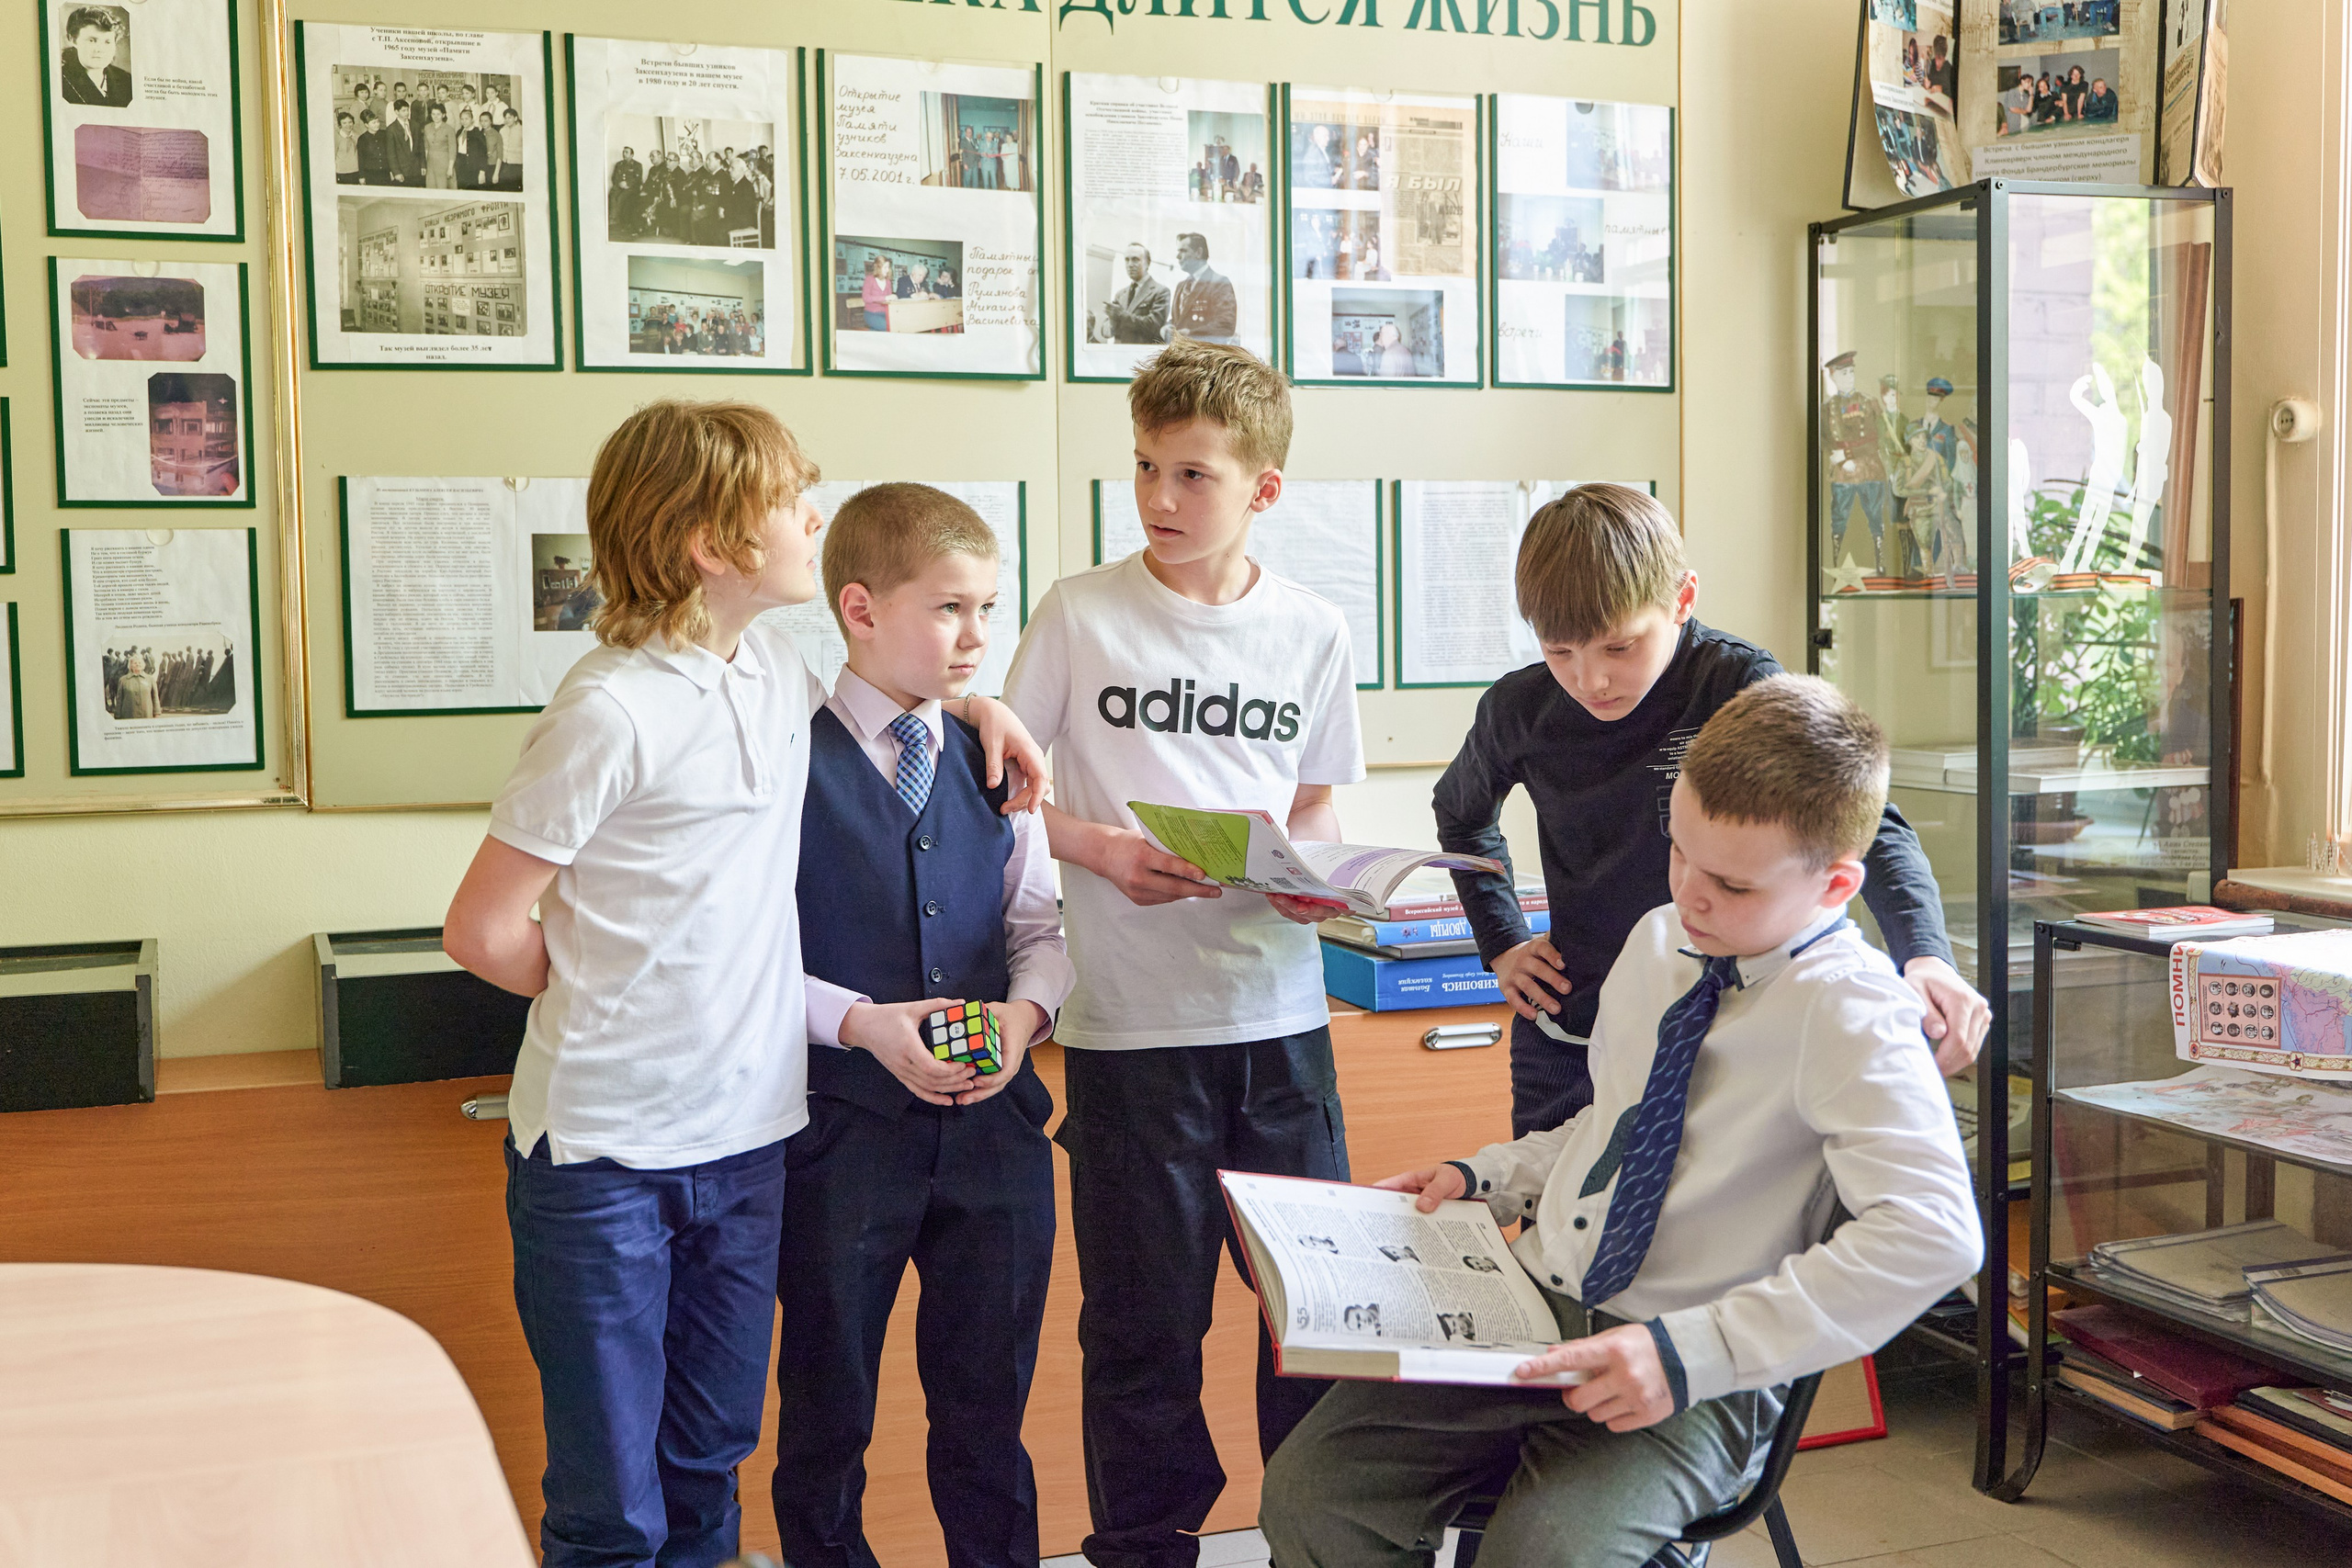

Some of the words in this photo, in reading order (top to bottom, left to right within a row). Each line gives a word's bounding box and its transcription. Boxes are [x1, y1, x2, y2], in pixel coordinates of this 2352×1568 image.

[641, 59, 672, 67] Встречи
[839, 85, 901, 102] Открытие
[836, 104, 876, 116] музея
[837, 114, 897, 132] Памяти
[837, 133, 887, 145] узников
[1984, 145, 2012, 153] Встреча
[2021, 142, 2052, 151] бывшим
[2053, 140, 2085, 149] узником
[835, 146, 918, 165] Заксенхаузена
[2001, 167, 2025, 175] Фонда
[1408, 176, 1463, 192] БЫЛ
[967, 266, 1014, 280] подарок
[472, 287, 510, 299] МУЗЕЯ
[967, 300, 1025, 311] Михаила
[1097, 678, 1301, 742] adidas
[1405, 907, 1442, 916] Всероссийский
[1430, 919, 1466, 938] ДВОРЦЫ
